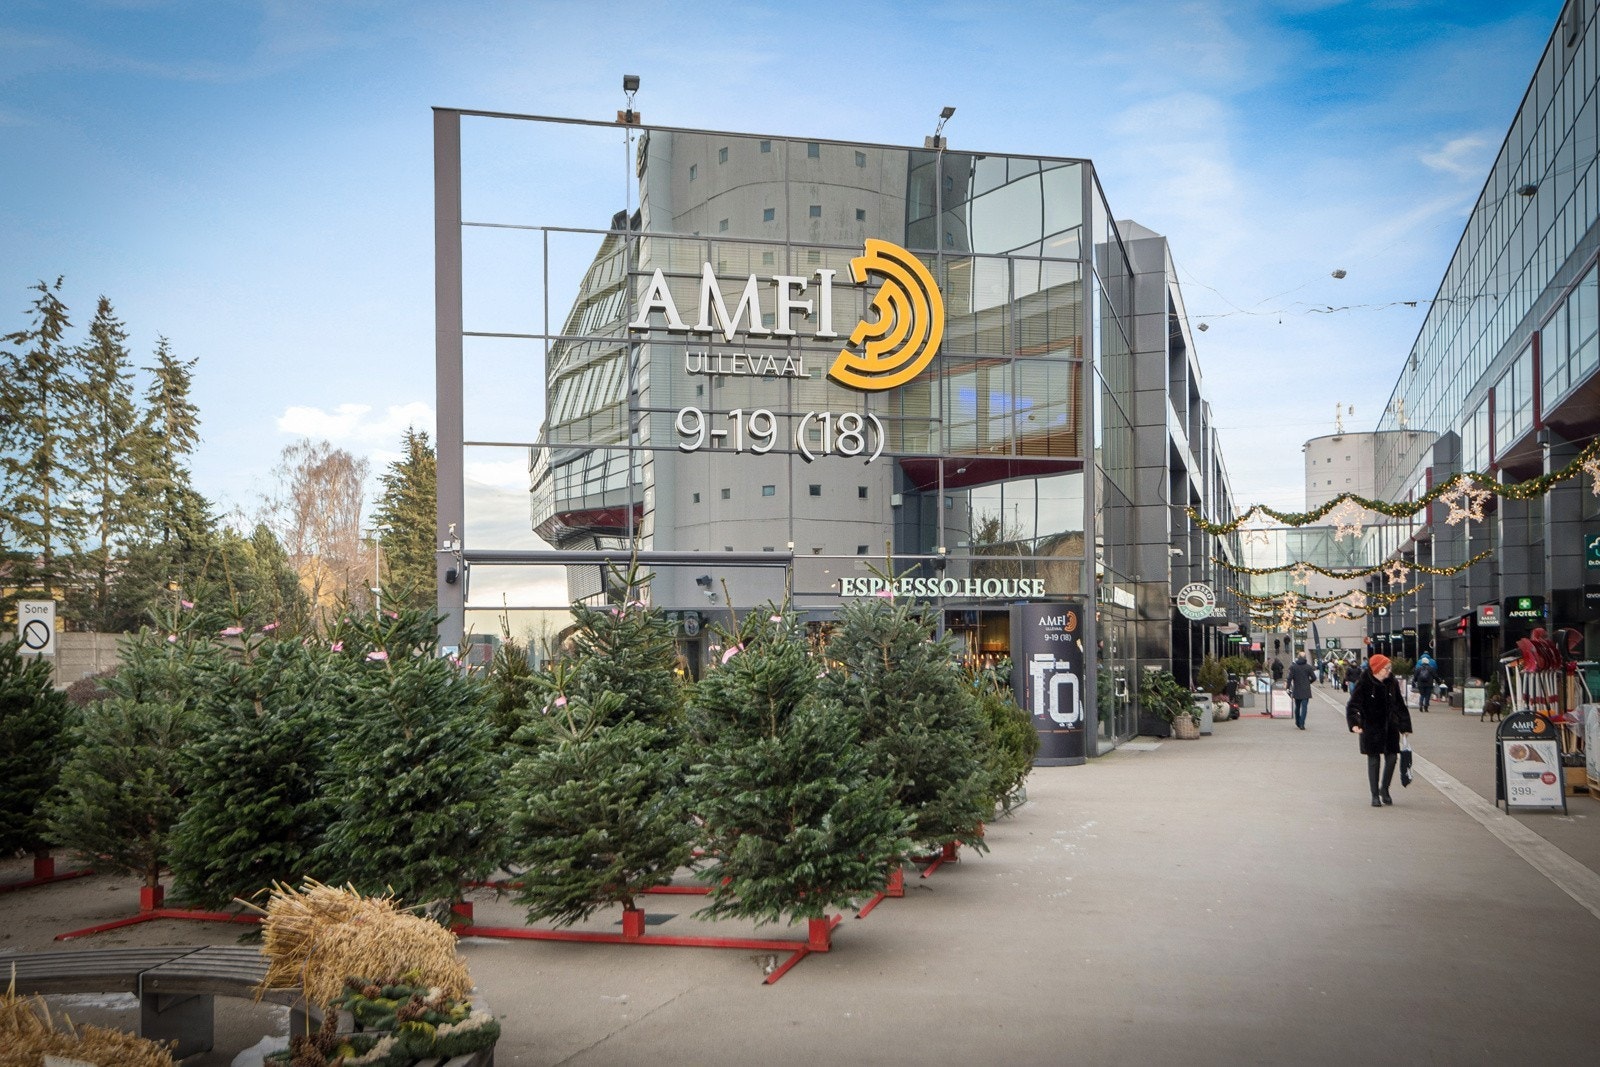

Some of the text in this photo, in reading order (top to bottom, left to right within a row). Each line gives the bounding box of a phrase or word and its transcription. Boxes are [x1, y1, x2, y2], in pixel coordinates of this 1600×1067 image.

[629, 262, 838, 341] AMFI
[685, 351, 811, 377] ULLEVAAL
[676, 406, 885, 464] 9-19 (18)
[839, 577, 1046, 598] ESPRESSO HOUSE
[1180, 585, 1213, 599] ESPRESSO
[25, 604, 48, 614] Sone
[1184, 608, 1210, 618] HOUSE
[1378, 606, 1387, 615] D
[1038, 615, 1066, 626] AMFI
[1044, 633, 1072, 642] 9-19 (18)
